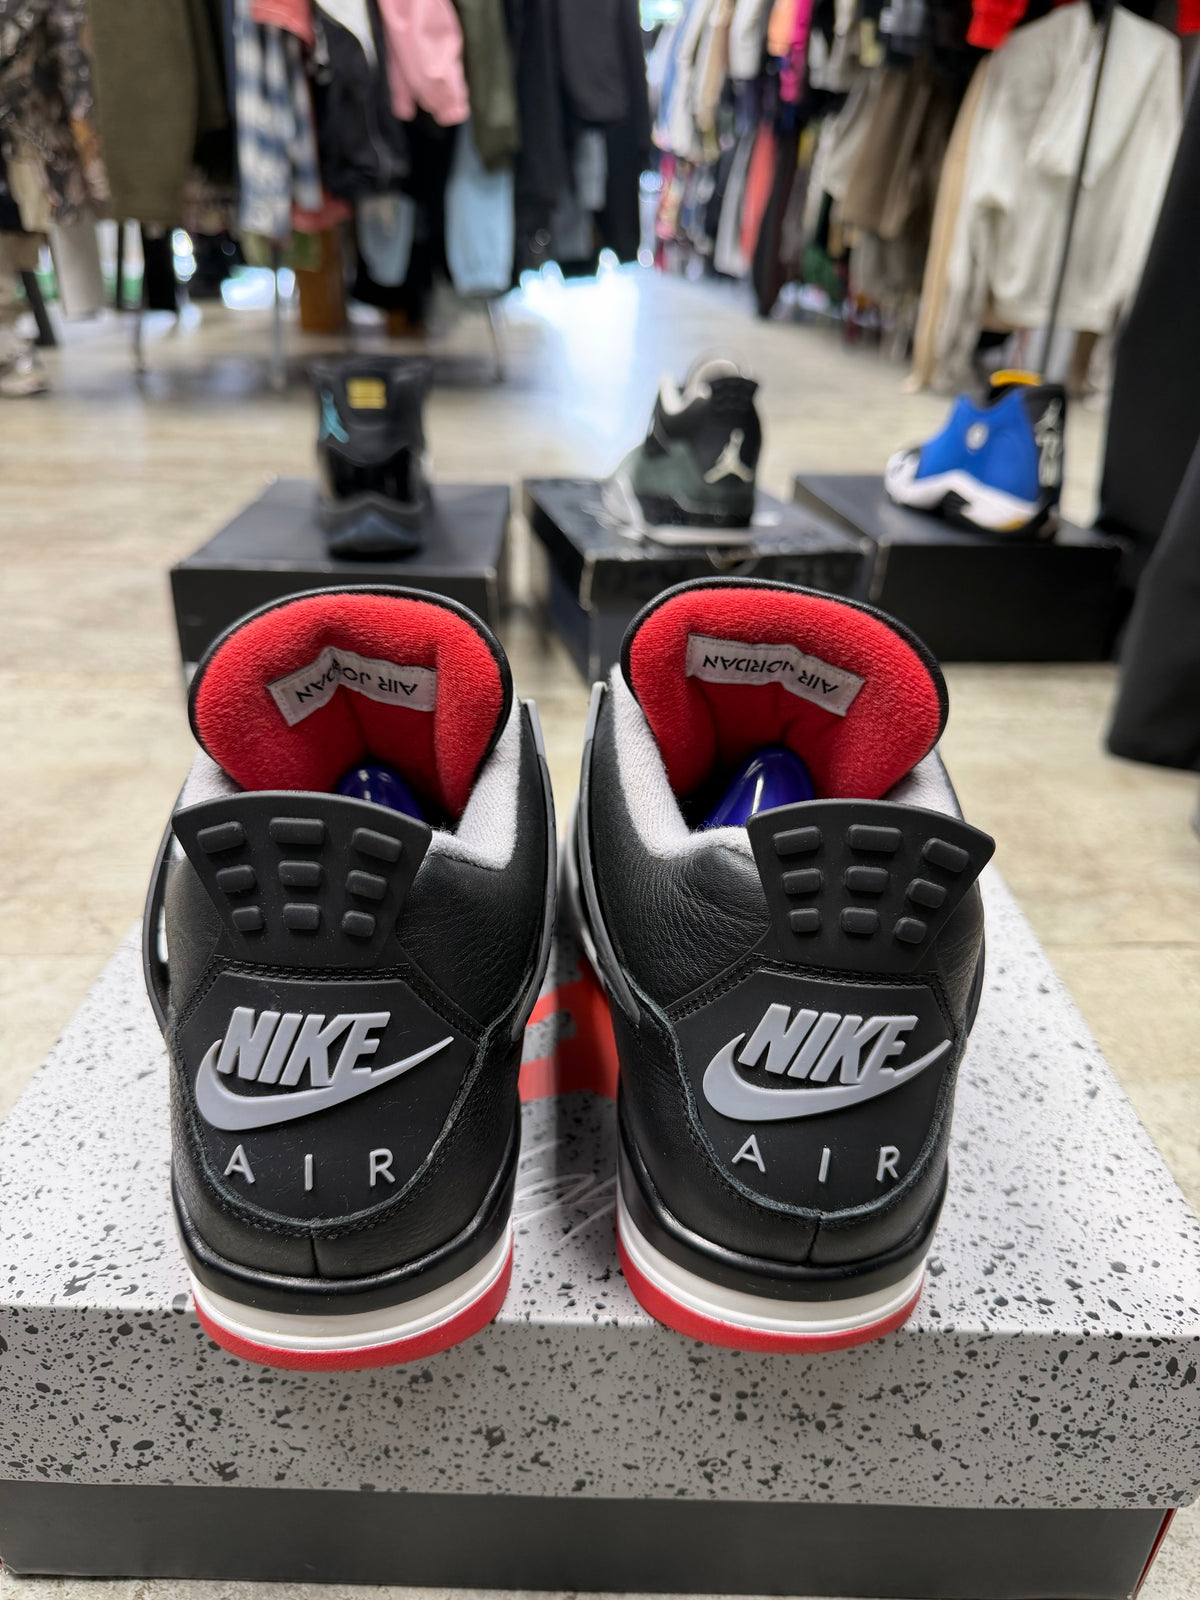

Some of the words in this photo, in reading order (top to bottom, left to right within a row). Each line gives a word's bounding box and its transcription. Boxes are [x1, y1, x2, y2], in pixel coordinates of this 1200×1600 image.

[378, 675, 418, 696] AIR
[702, 655, 795, 674] JORDAN
[797, 669, 839, 694] AIR
[216, 1006, 391, 1087] NIKE
[737, 1003, 919, 1084] NIKE
[223, 1144, 396, 1191] AIR
[731, 1134, 900, 1183] AIR
